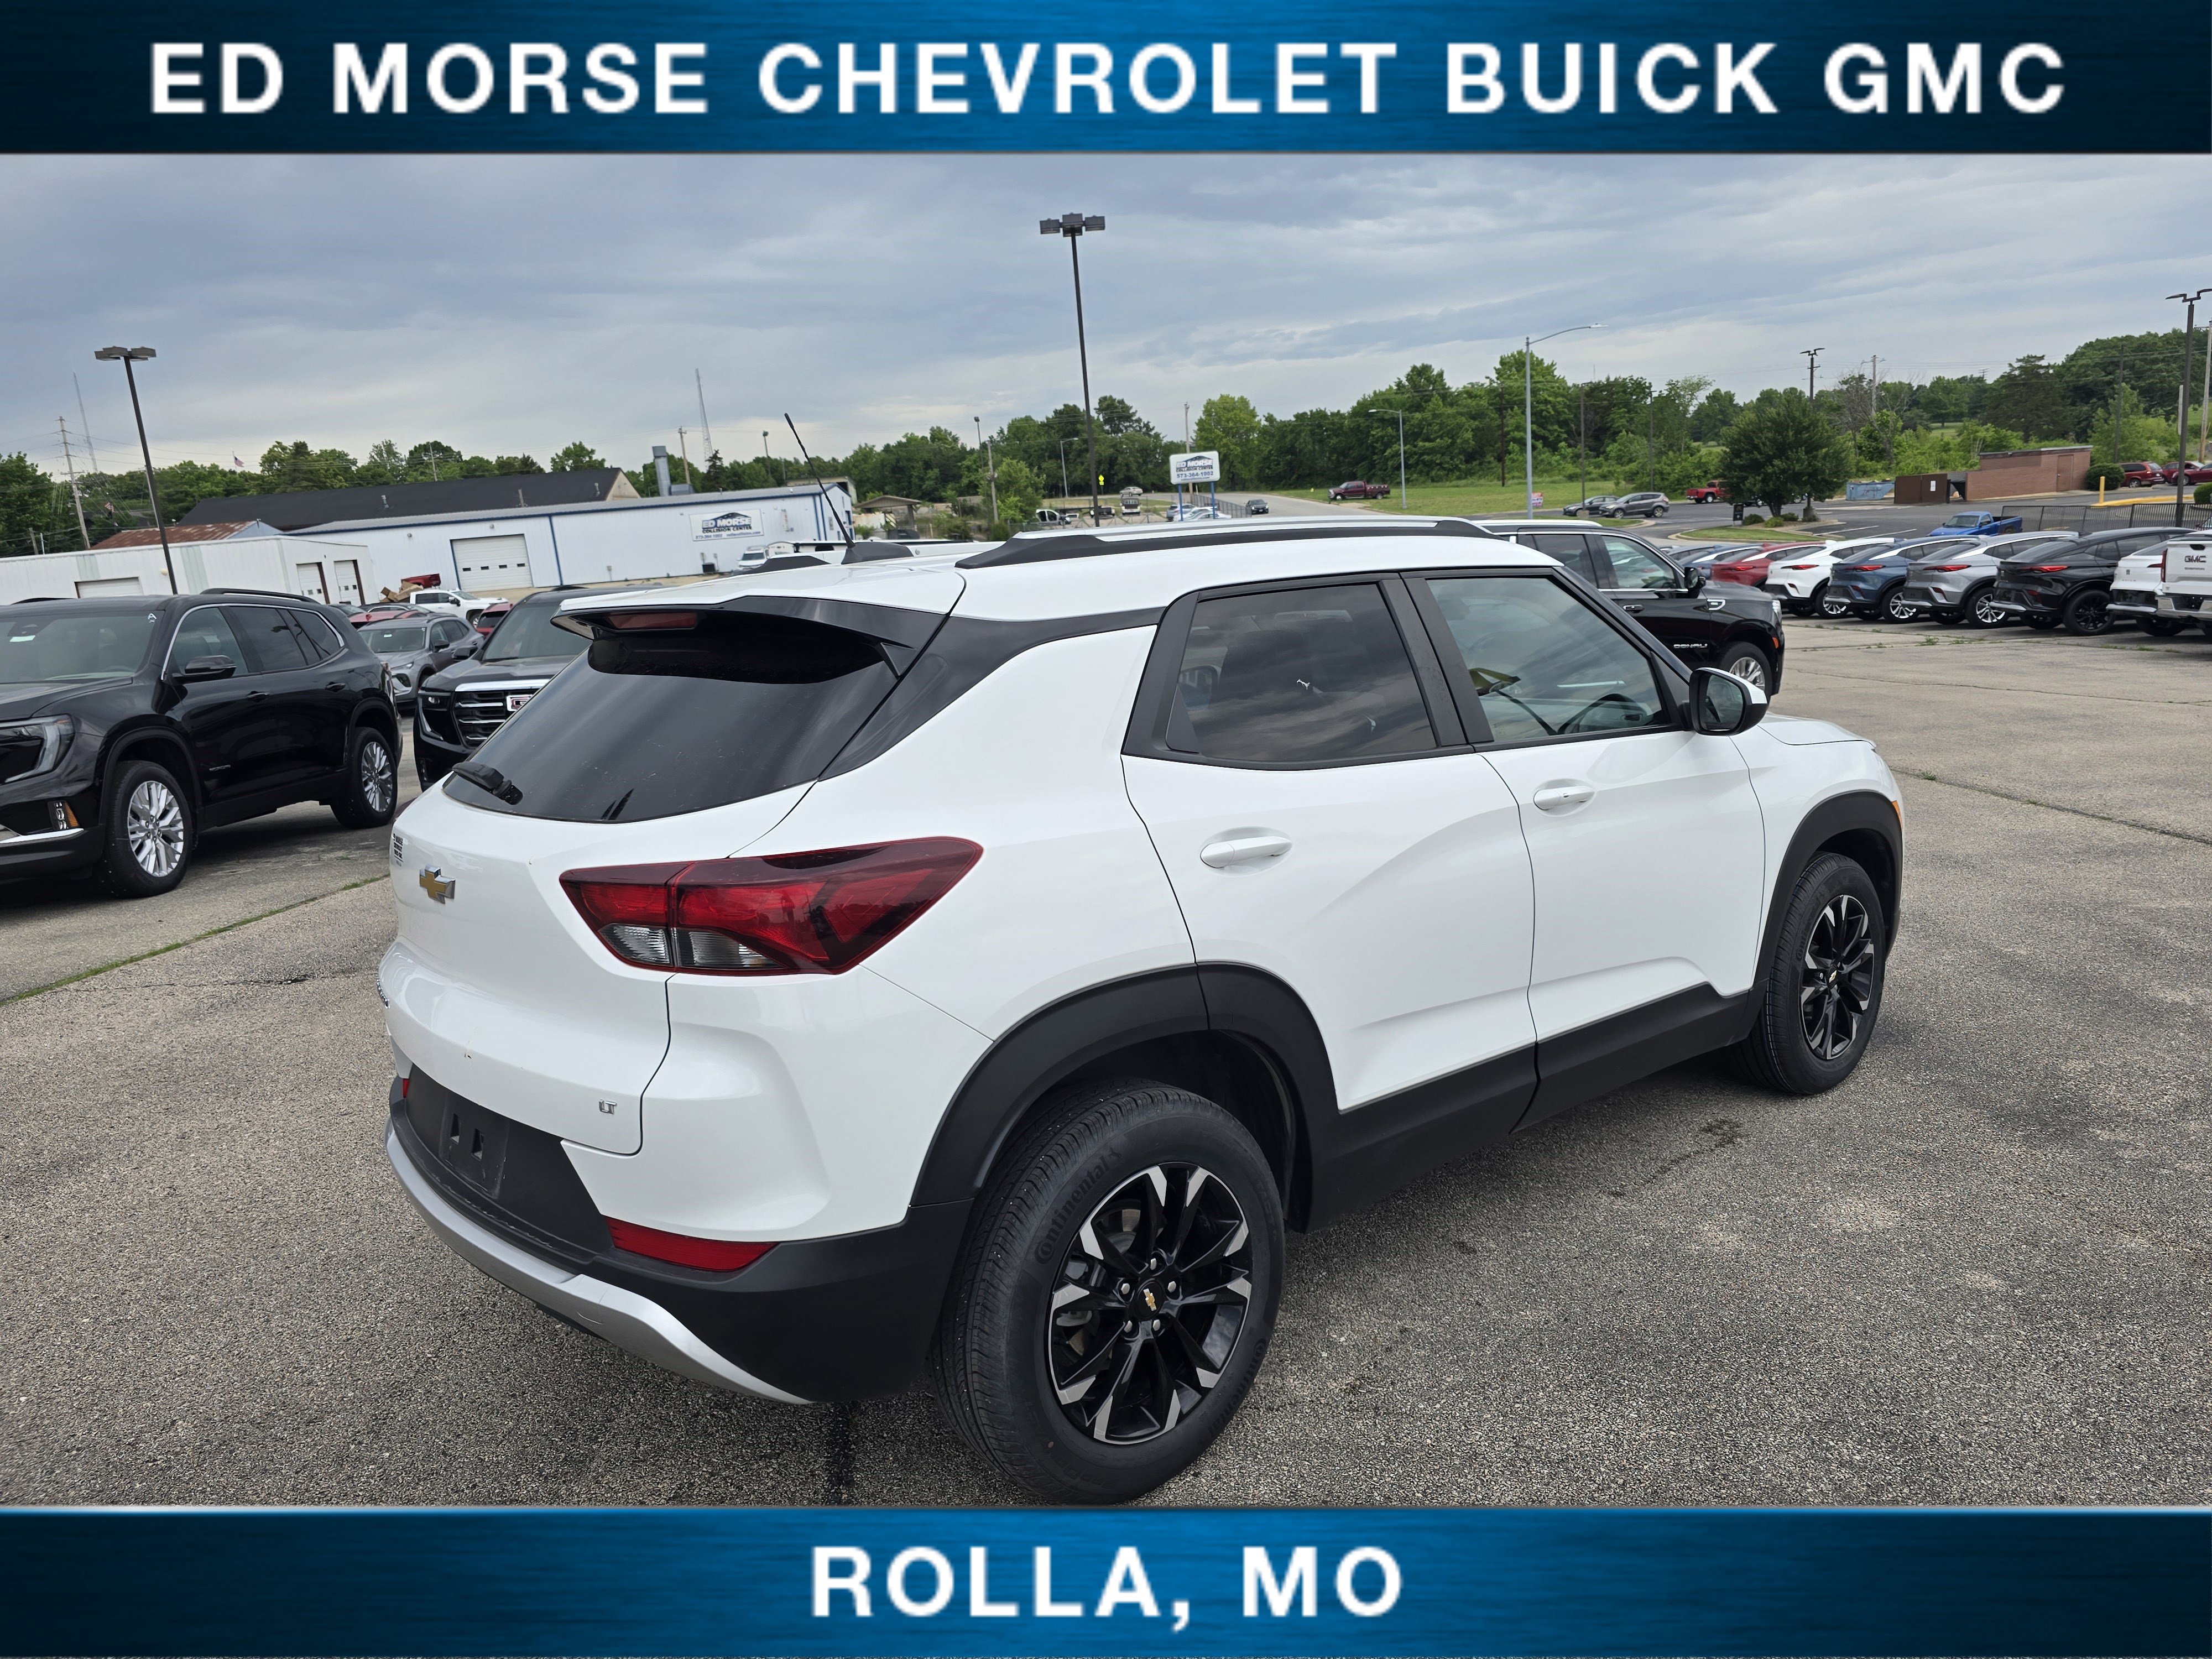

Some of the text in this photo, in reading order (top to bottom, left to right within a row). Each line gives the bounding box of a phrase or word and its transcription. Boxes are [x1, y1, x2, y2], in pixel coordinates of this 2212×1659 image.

[702, 517, 752, 528] ED MORSE
[599, 1100, 617, 1115] LT
[1035, 1156, 1108, 1264] Continental
